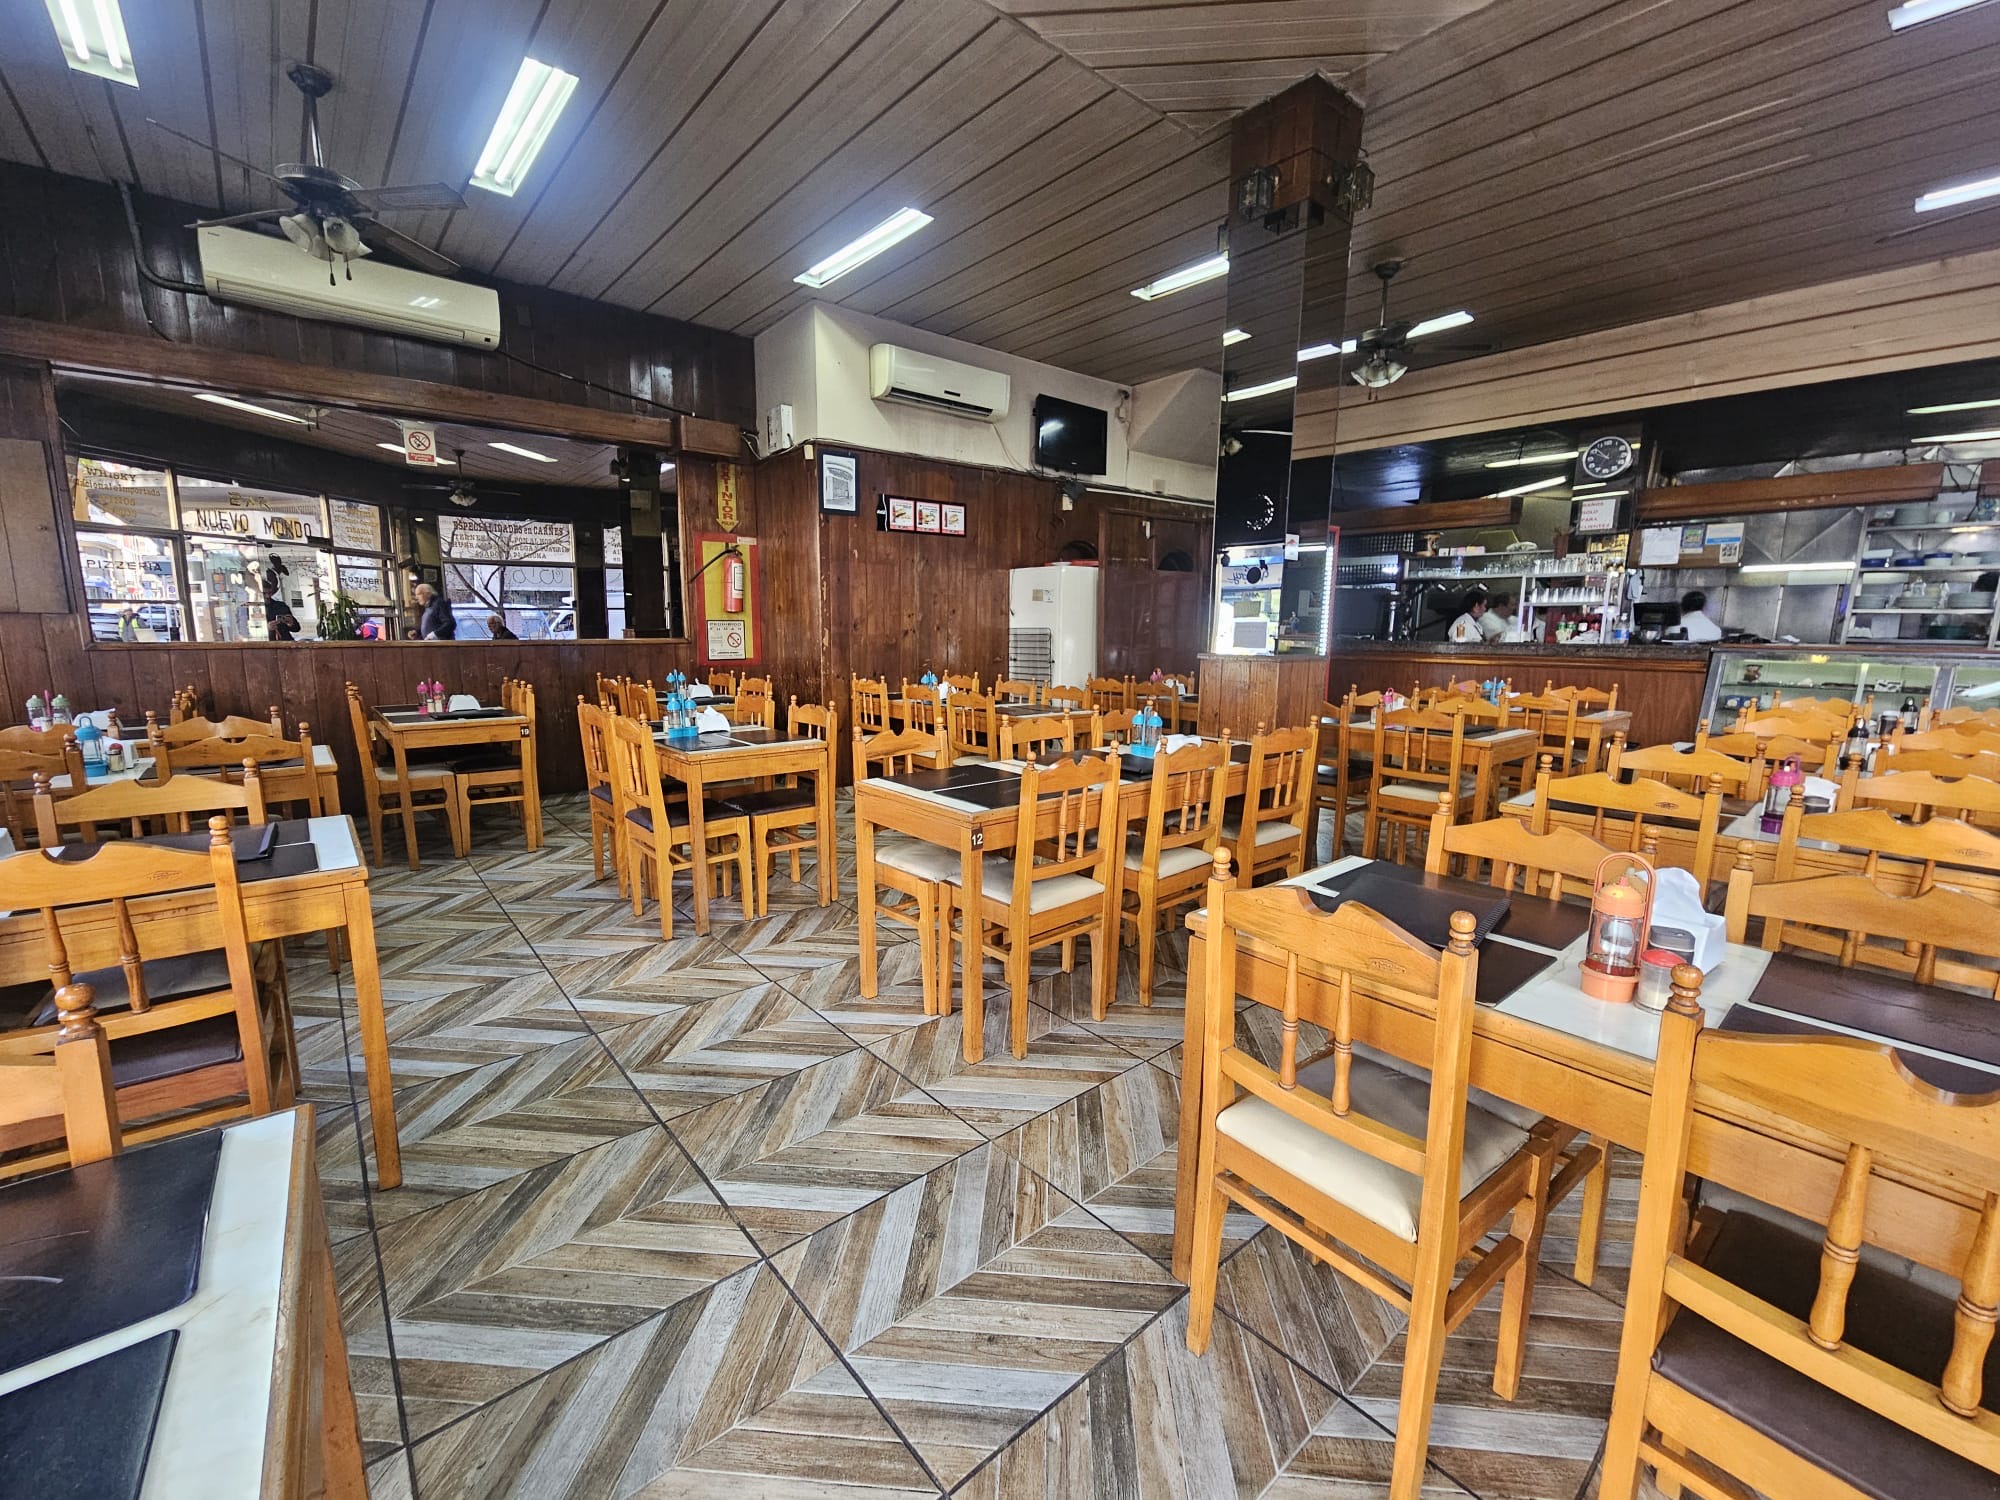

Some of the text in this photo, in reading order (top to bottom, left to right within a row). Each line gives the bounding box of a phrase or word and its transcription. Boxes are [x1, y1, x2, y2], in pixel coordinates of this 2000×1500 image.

[195, 508, 250, 533] NUEVO
[263, 516, 313, 541] MONDO
[452, 520, 522, 535] ESPECIALIDADES
[534, 526, 563, 536] CARNES
[86, 559, 163, 572] PIZZERIA
[971, 833, 983, 846] 12
